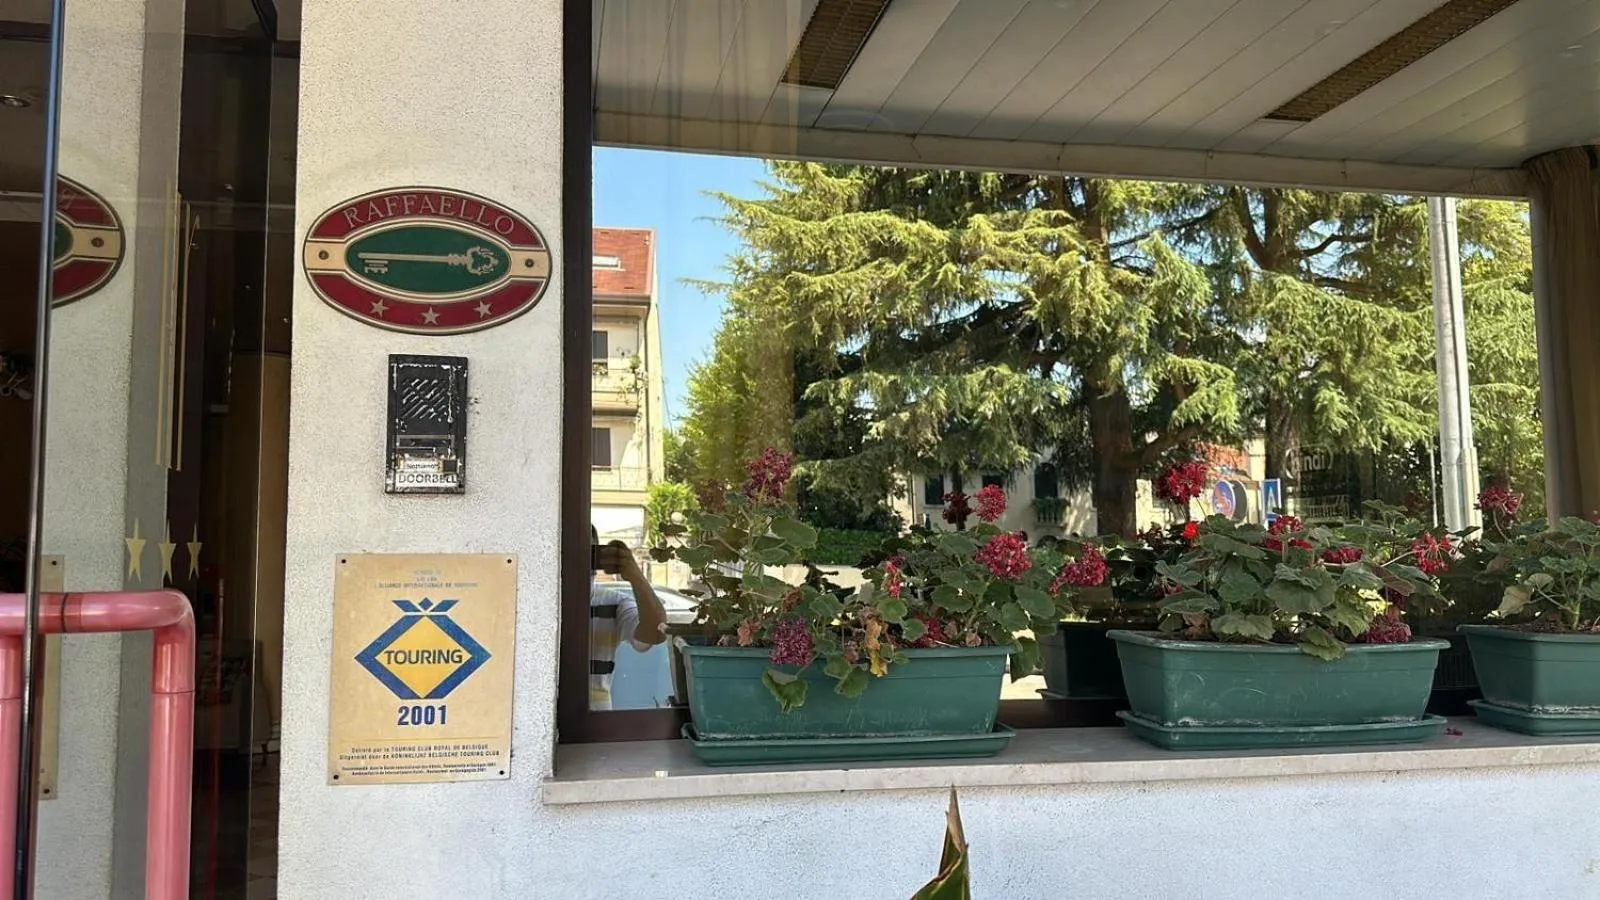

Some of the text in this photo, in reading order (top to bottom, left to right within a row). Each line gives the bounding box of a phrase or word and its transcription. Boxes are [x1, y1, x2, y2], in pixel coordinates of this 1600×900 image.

[343, 194, 515, 236] RAFFAELLO
[398, 473, 457, 483] DOORBELL
[384, 649, 463, 665] TOURING
[397, 705, 447, 726] 2001
